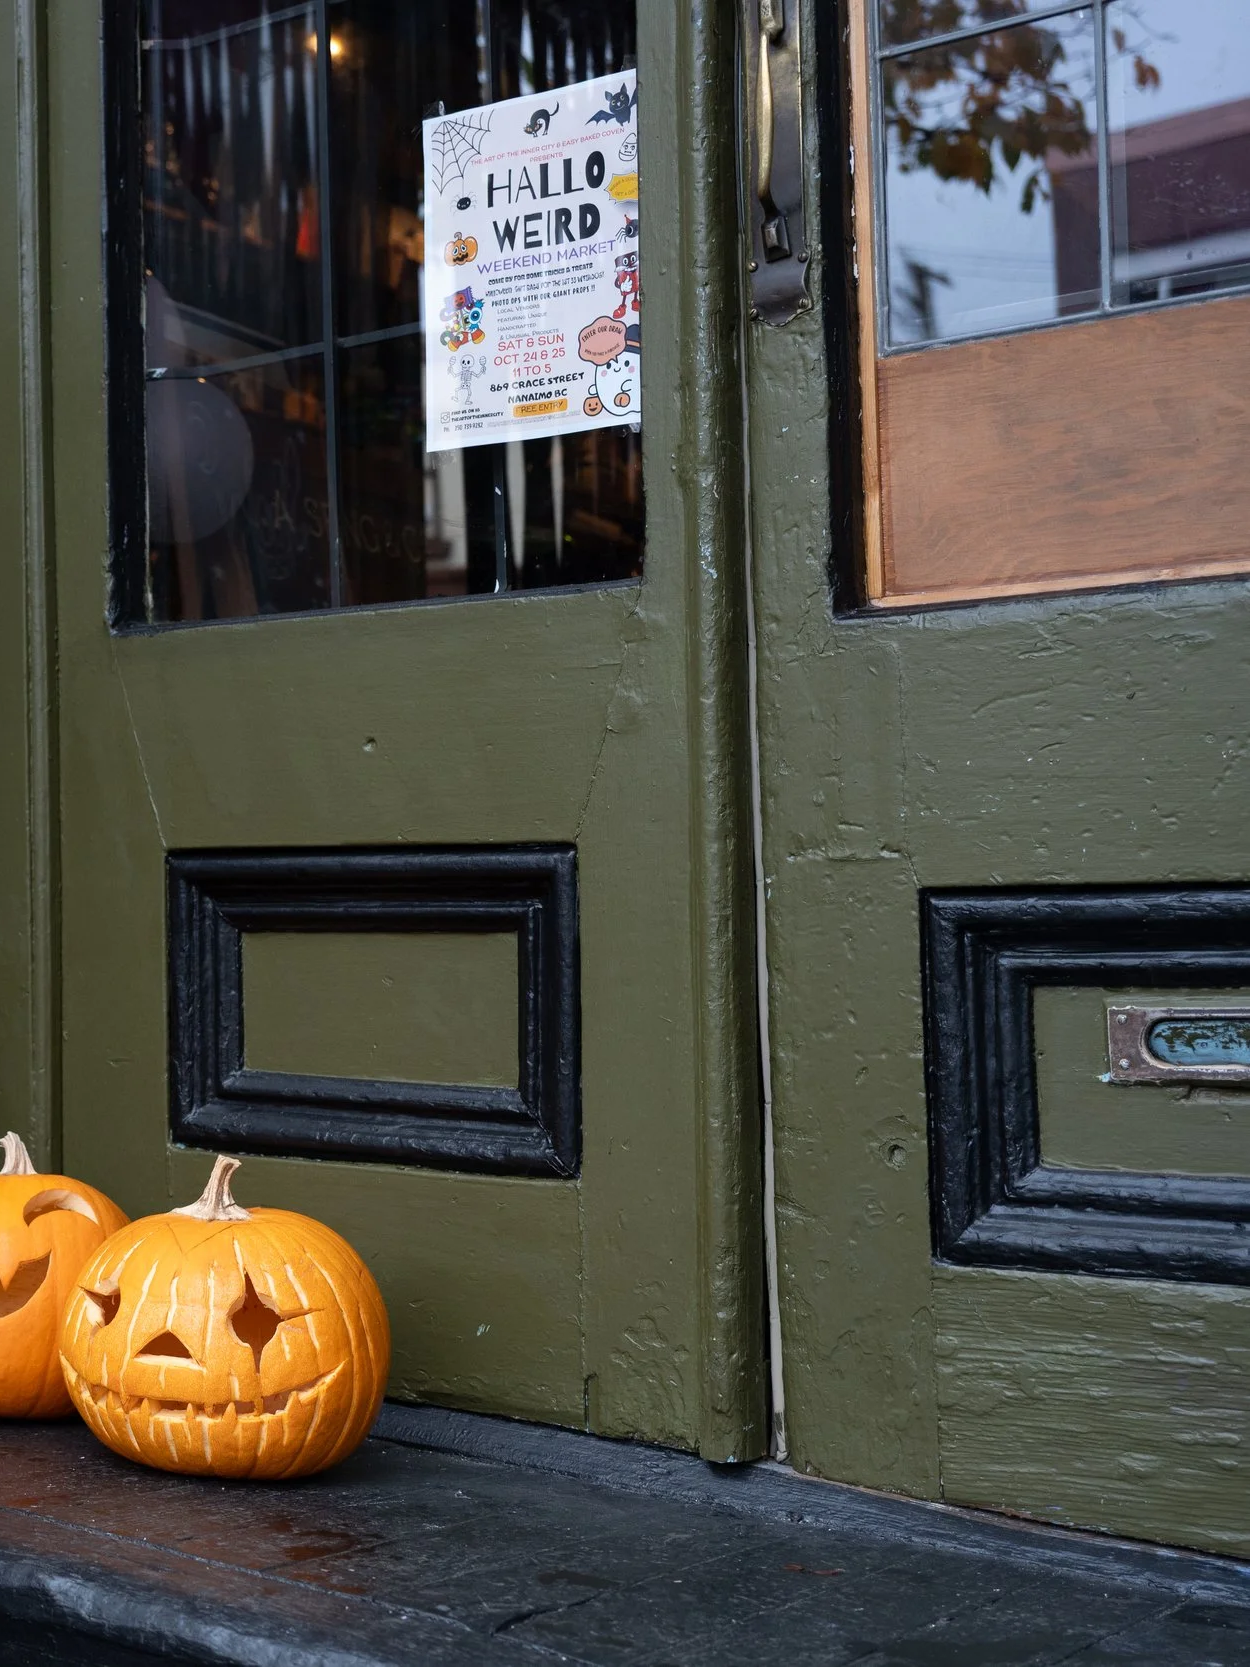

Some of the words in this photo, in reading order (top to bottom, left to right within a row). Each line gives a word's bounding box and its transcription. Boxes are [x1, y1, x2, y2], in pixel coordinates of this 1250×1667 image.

[520, 146, 540, 155] INNER
[541, 143, 555, 151] CITY
[562, 137, 579, 147] EASY
[580, 132, 601, 142] BAKED
[602, 127, 625, 138] COVEN
[529, 151, 564, 163] PRESENTS
[487, 150, 606, 208] HALLO
[492, 203, 600, 253] WEIRD
[477, 253, 553, 275] WEEKEND
[557, 239, 616, 263] MARKET
[491, 298, 510, 307] PHOTO
[511, 296, 521, 304] OPS
[522, 294, 538, 302] WITH
[552, 288, 571, 297] GIANT
[572, 286, 590, 294] PROPS
[498, 339, 523, 351] SAT
[526, 338, 534, 348] &
[538, 333, 564, 346] SUN
[581, 329, 596, 342] ENTER
[598, 325, 607, 333] OUR
[493, 353, 519, 366] OCT
[523, 351, 538, 362] 24
[540, 349, 548, 360] &
[552, 347, 566, 358] 25
[513, 367, 521, 377] 11
[524, 365, 541, 376] TO
[544, 363, 551, 373] 5
[489, 382, 509, 392] 869
[511, 378, 546, 389] CRACE
[547, 371, 585, 385] STREET
[507, 391, 553, 404] NANAIMO
[554, 388, 568, 398] BC
[515, 403, 537, 414] FREE
[538, 401, 564, 411] ENTRY
